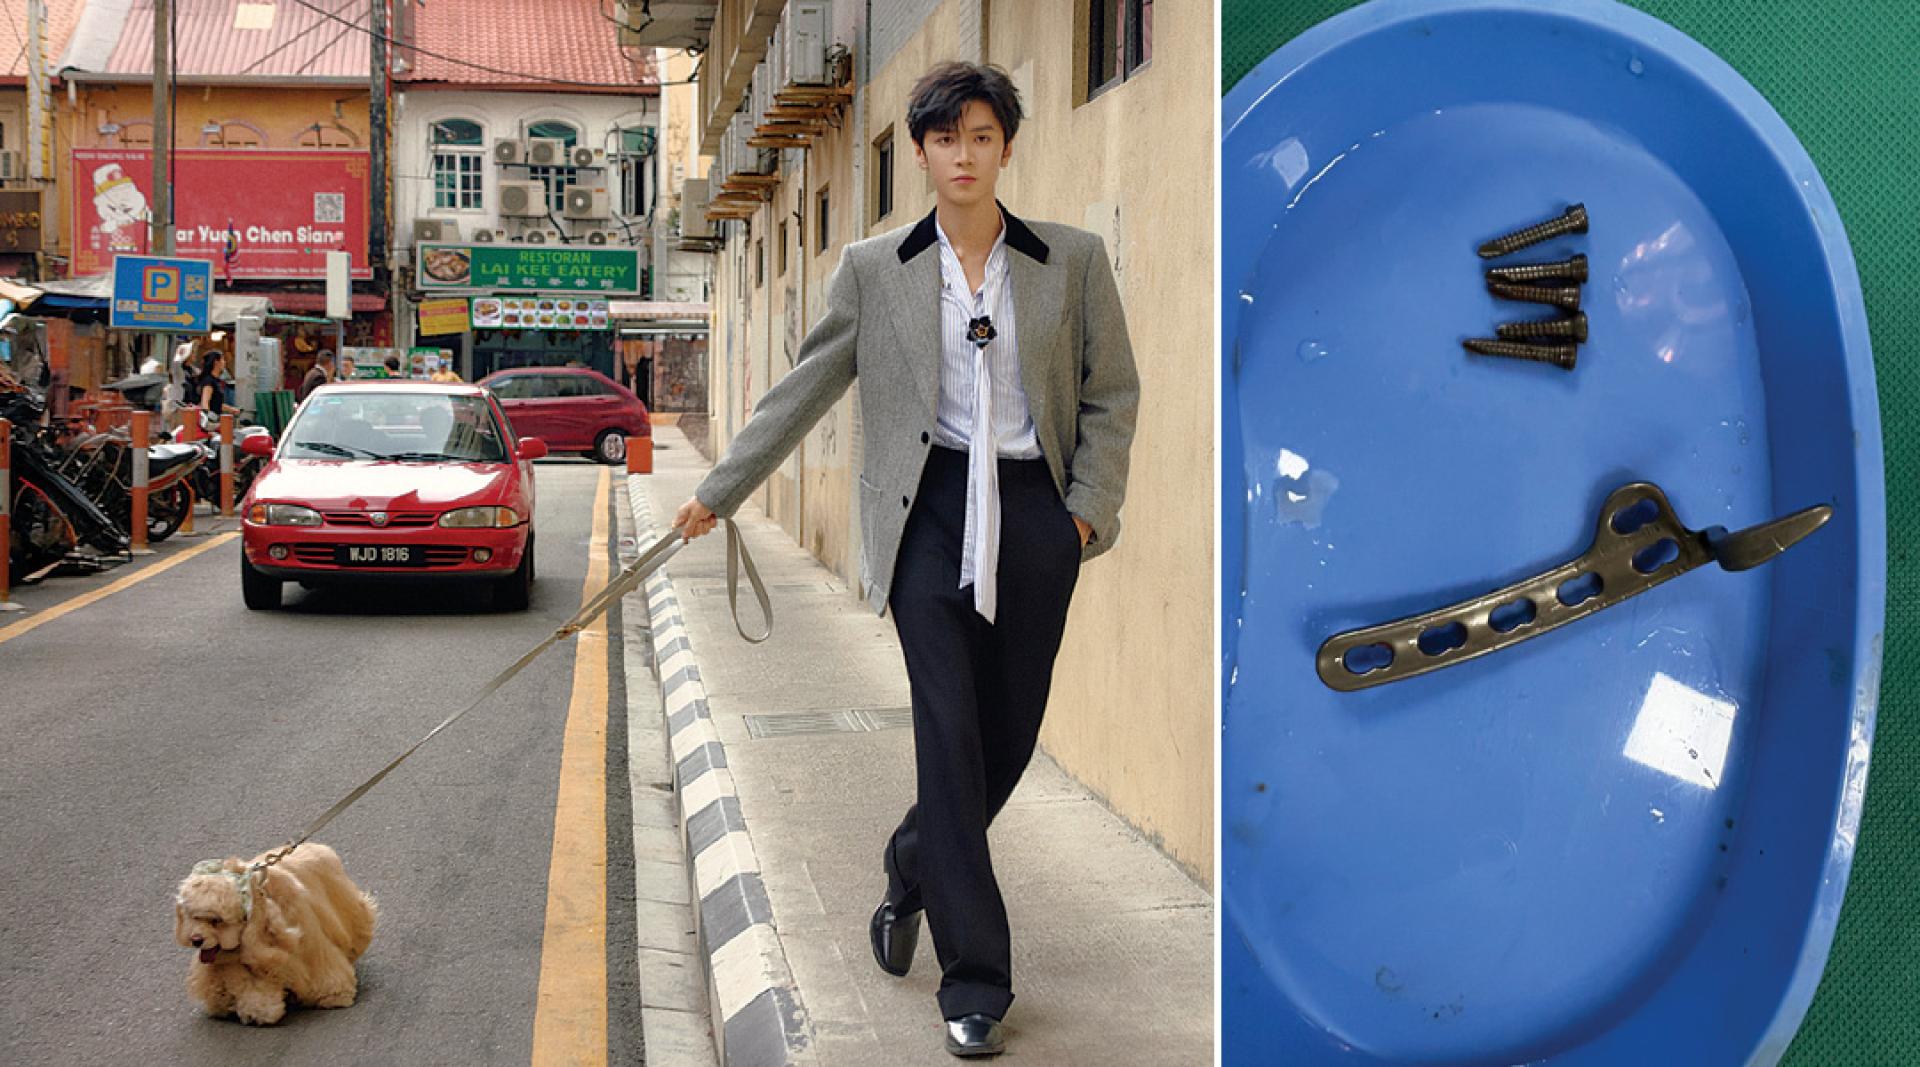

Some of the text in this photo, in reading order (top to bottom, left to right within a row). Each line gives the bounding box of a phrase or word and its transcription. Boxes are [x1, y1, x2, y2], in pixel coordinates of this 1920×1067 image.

[246, 225, 293, 242] Chen
[520, 251, 591, 264] RESTORAN
[481, 263, 628, 278] LAI KEE EATERY
[151, 272, 171, 298] P
[349, 547, 410, 561] WJD 1816
